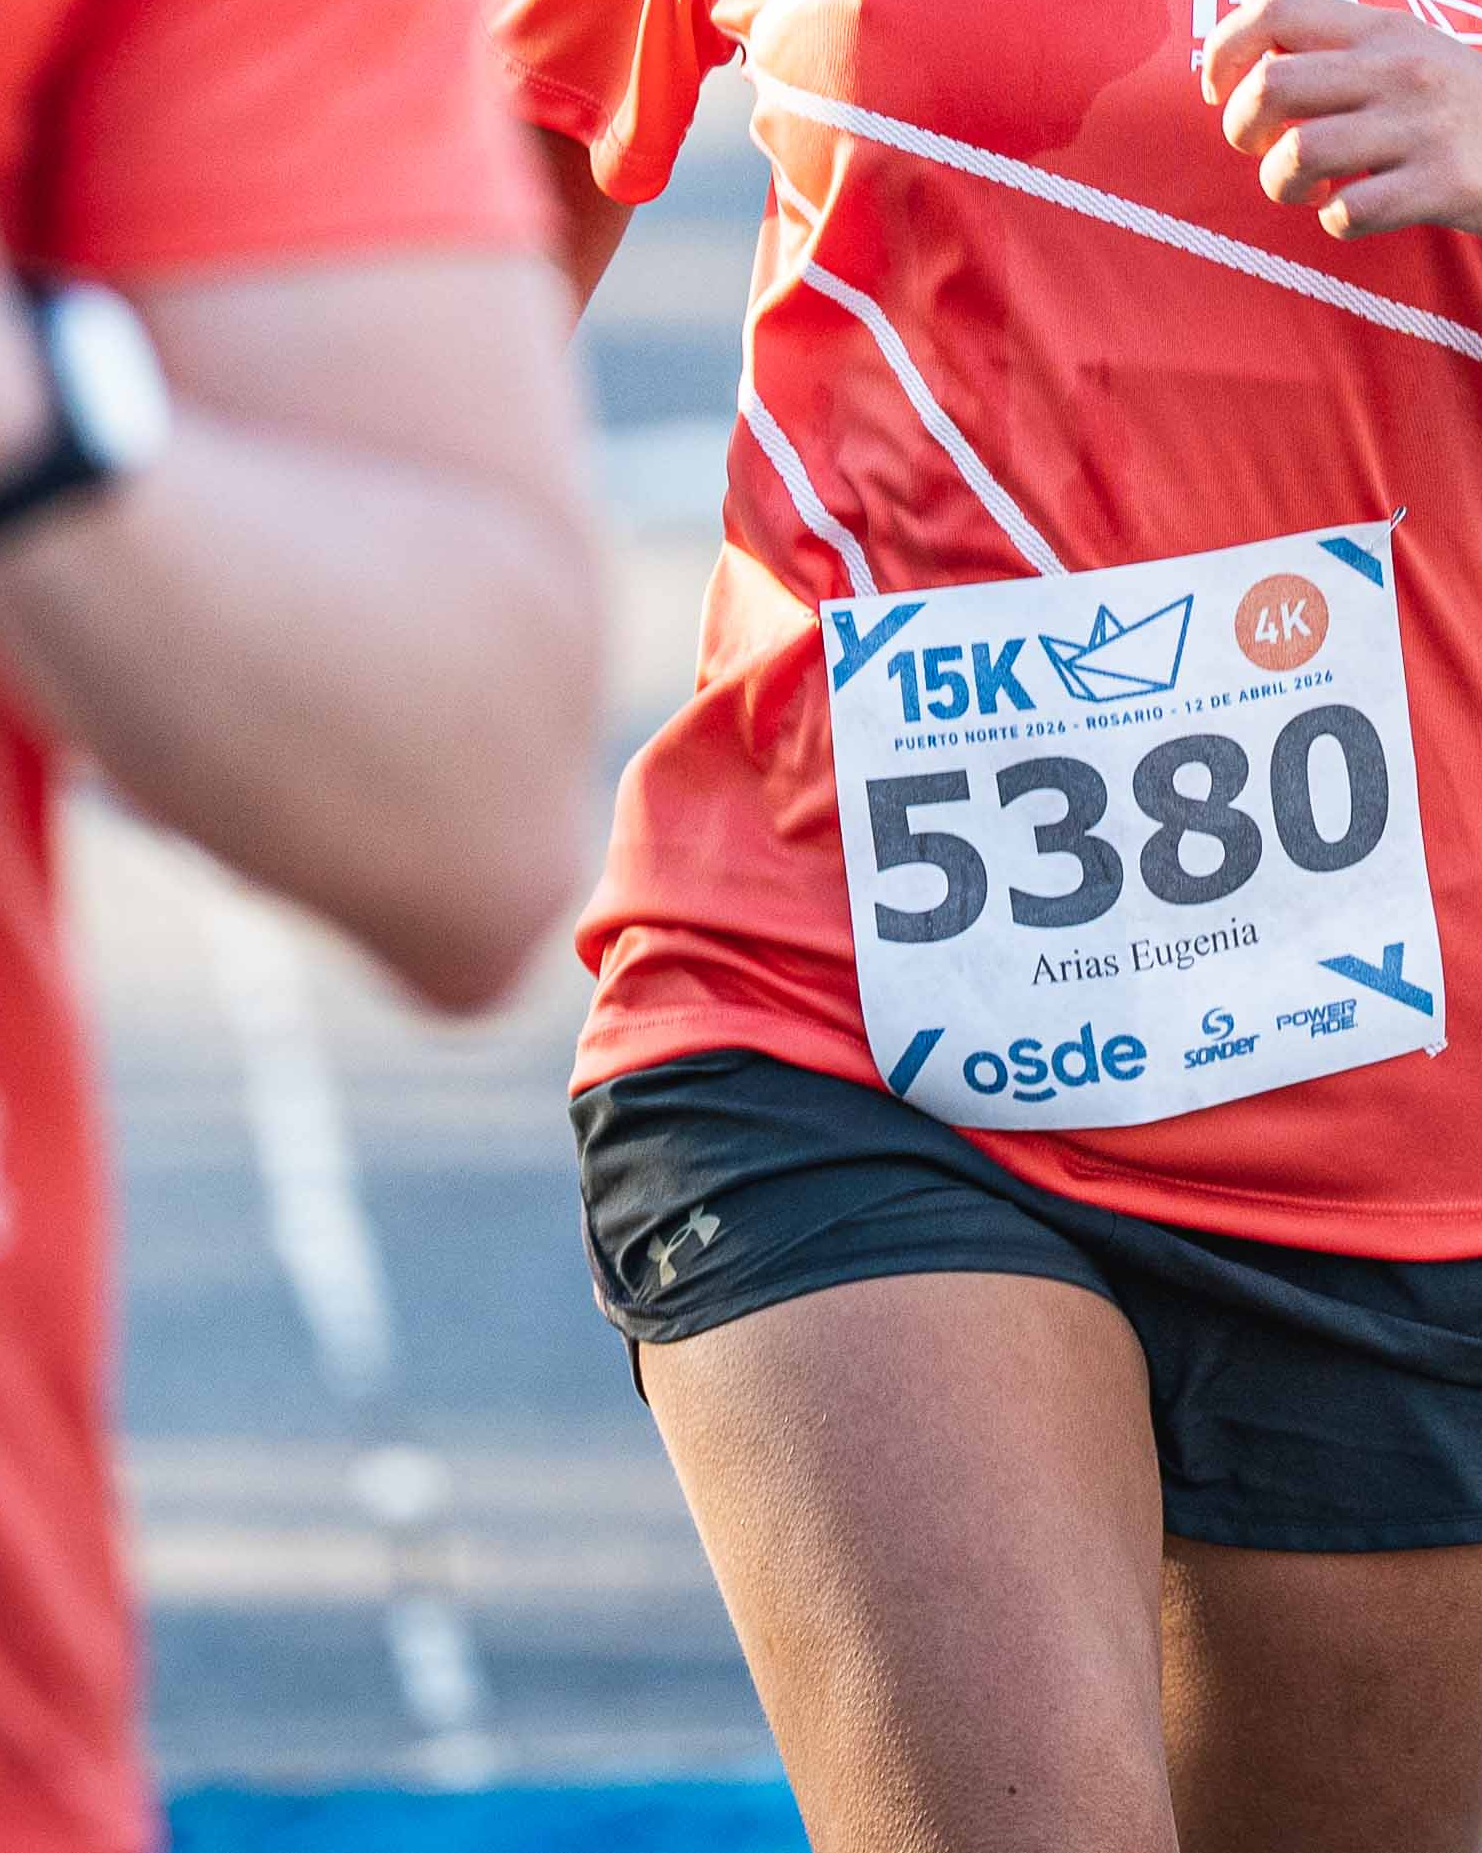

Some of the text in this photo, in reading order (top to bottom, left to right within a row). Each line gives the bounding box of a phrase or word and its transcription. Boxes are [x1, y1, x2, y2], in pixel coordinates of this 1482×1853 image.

[887, 599, 1311, 723] 15K 4K
[894, 732, 958, 752] PUERTO
[967, 724, 1018, 744] NORTE
[1026, 719, 1066, 738] 2026
[1086, 706, 1163, 730] ROSARIO
[1185, 700, 1203, 714] 12
[1211, 692, 1232, 708] DE
[1239, 681, 1287, 704] ABRIL
[1294, 669, 1333, 690] 2026
[864, 703, 1390, 945] 5380
[1030, 918, 1260, 987] Arias Eugenia
[1276, 998, 1358, 1031] POWER
[963, 1021, 1148, 1102] osde
